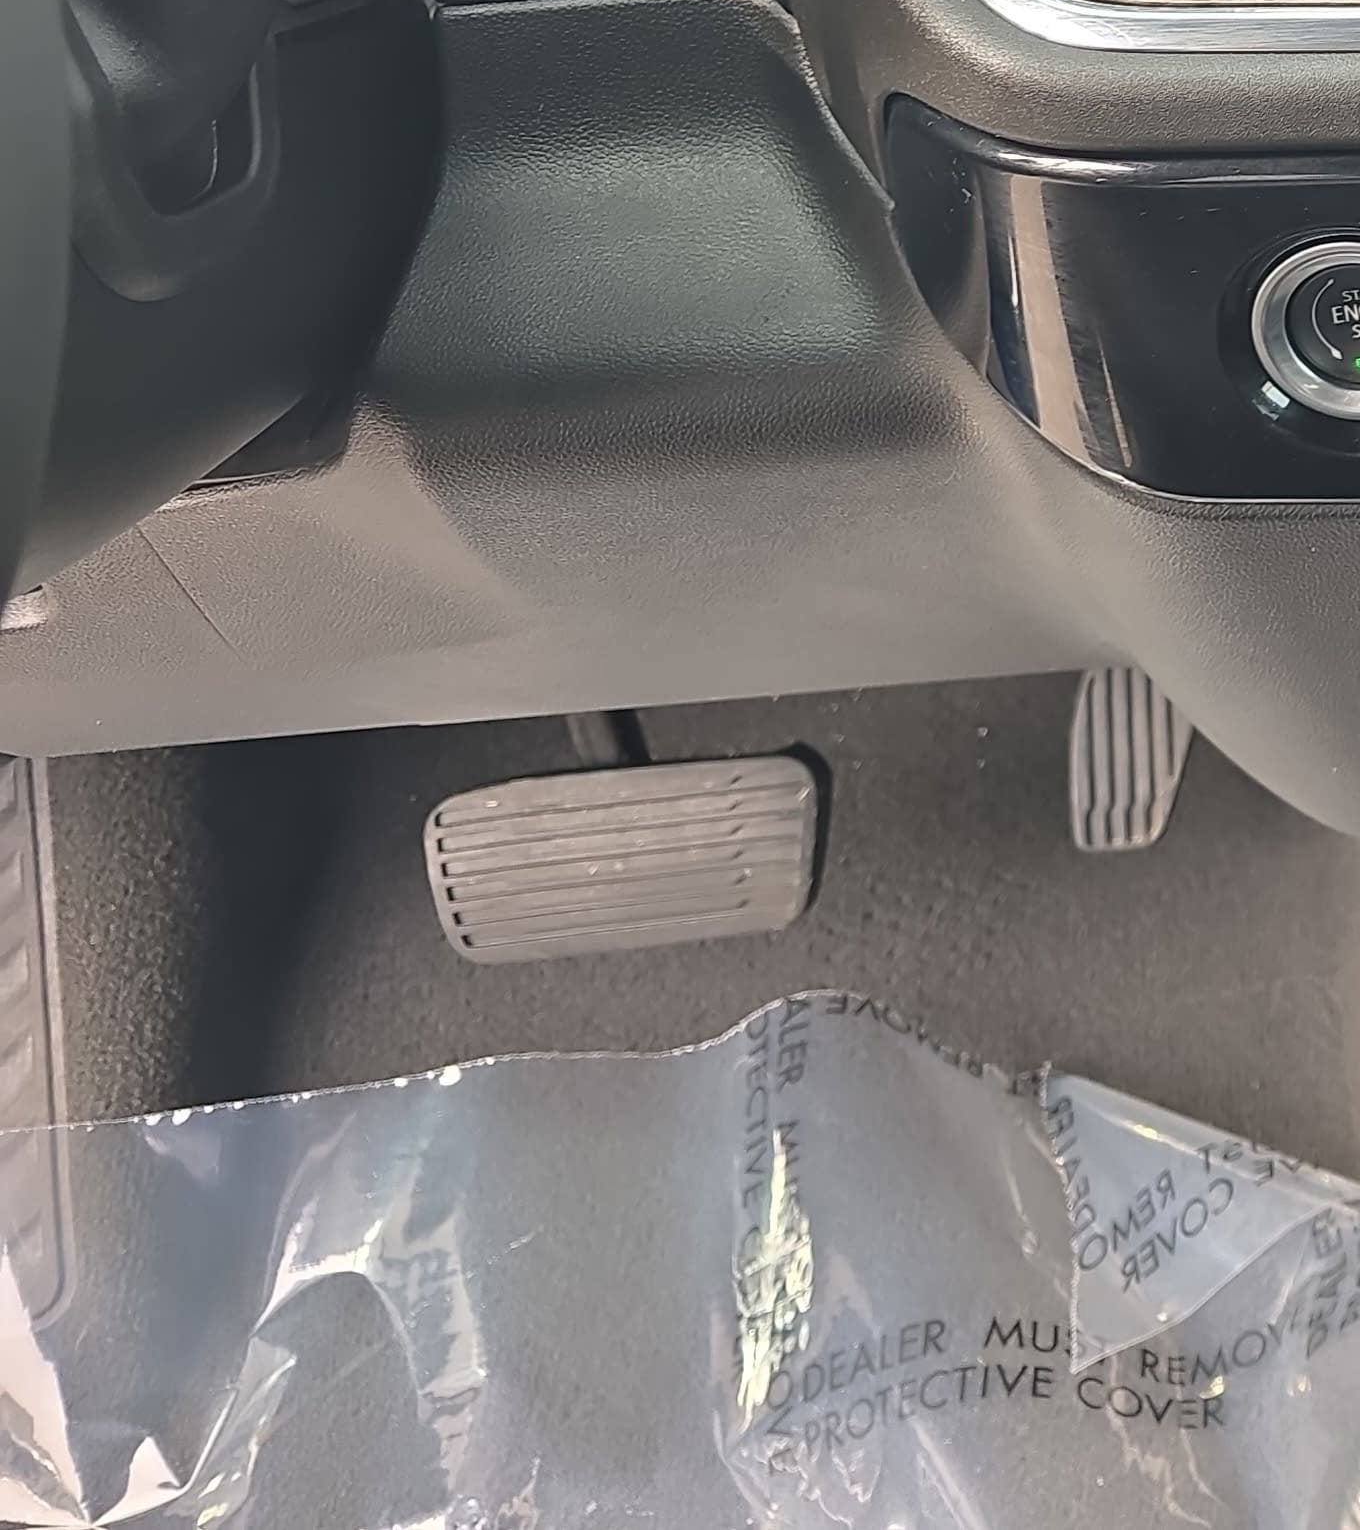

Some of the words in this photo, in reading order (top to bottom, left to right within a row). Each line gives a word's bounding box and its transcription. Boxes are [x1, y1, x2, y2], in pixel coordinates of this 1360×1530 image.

[798, 1318, 947, 1405] DEALER
[799, 1362, 1054, 1456] PROTECTIVE
[1076, 1374, 1230, 1432] COVER
